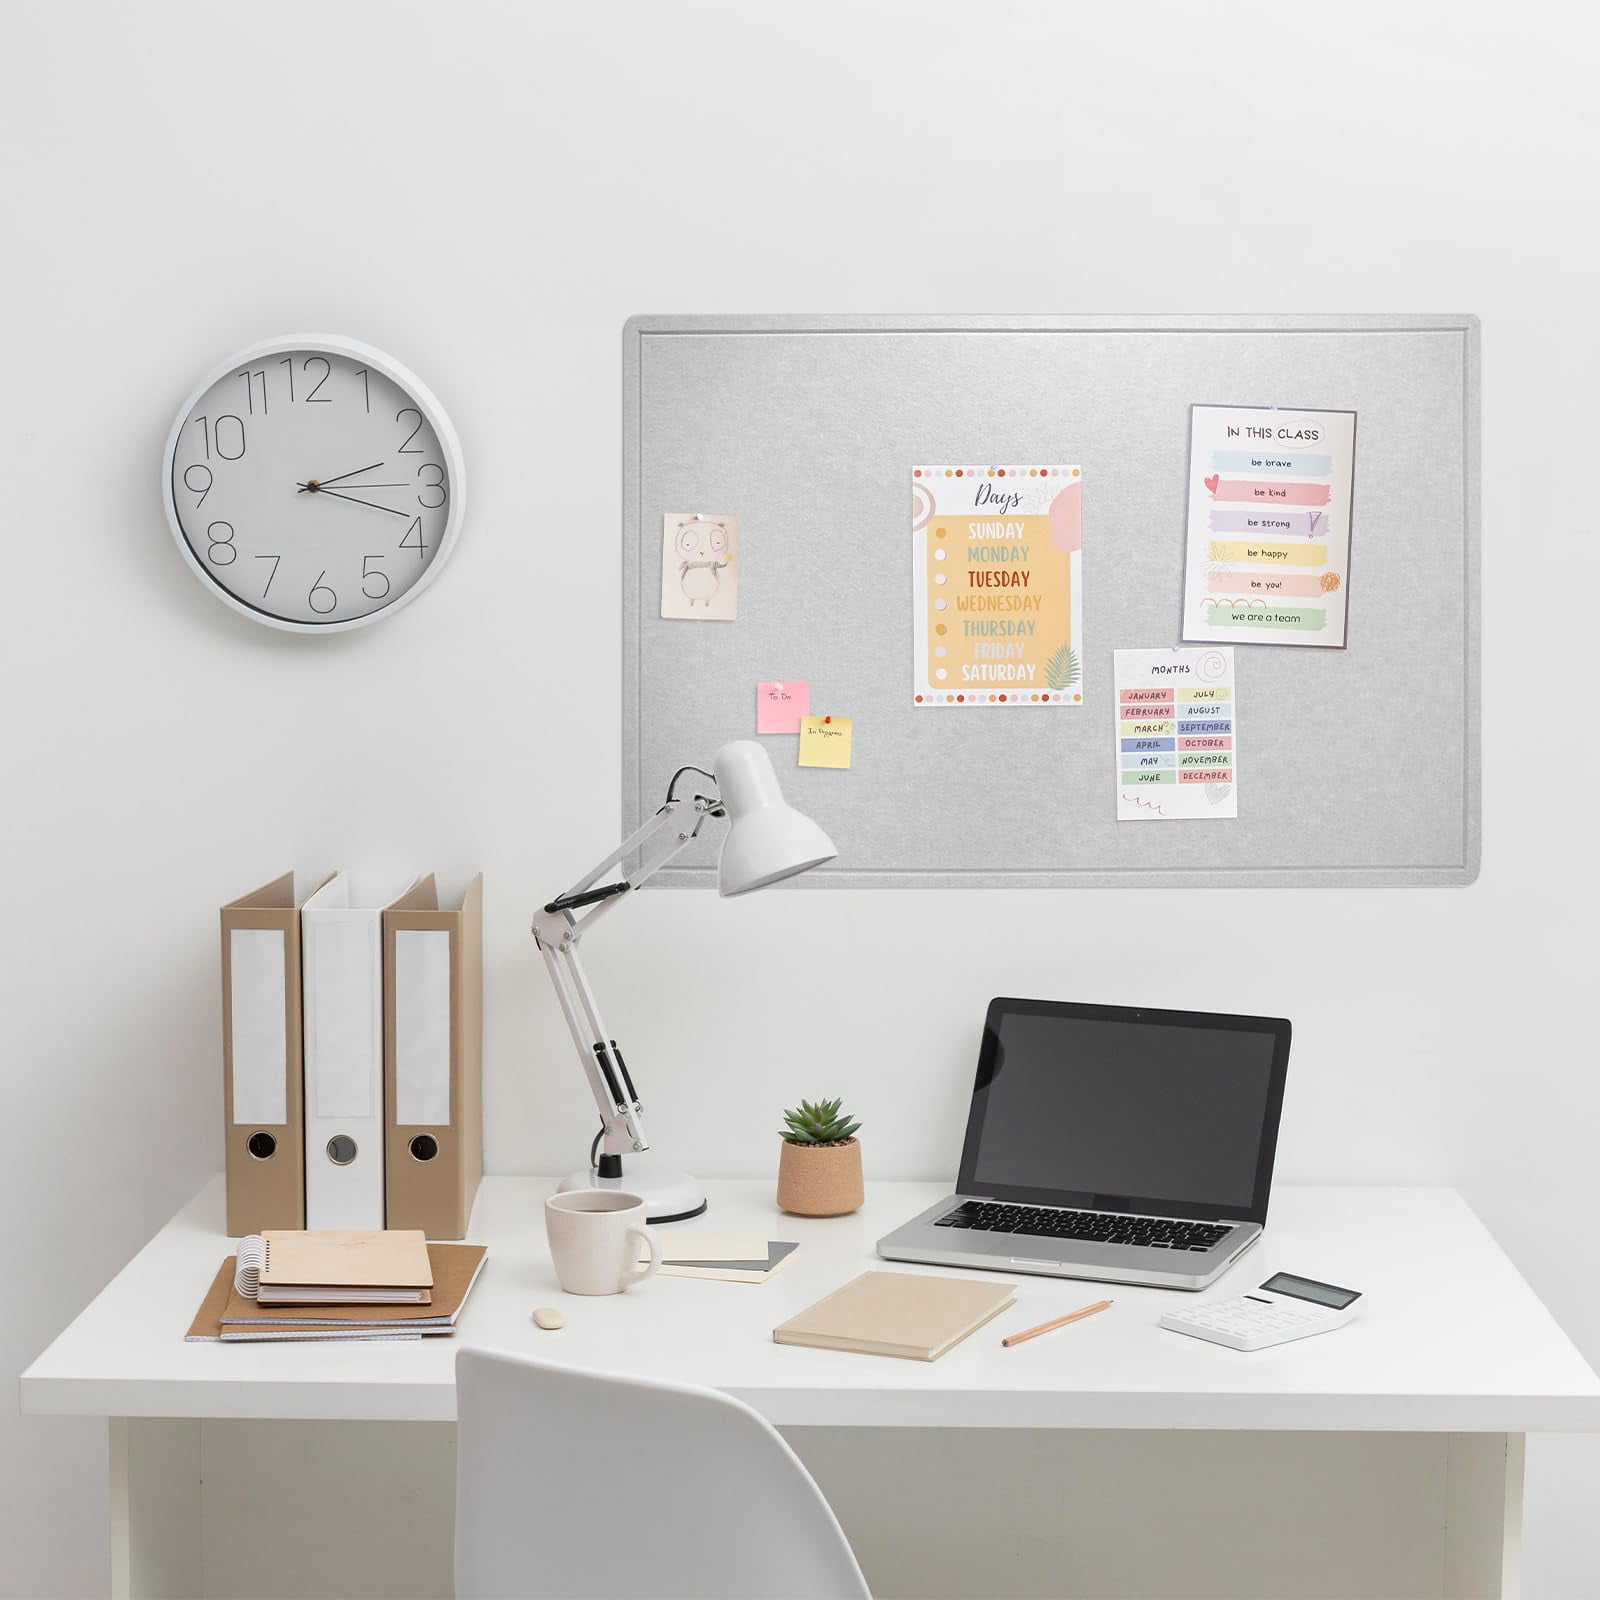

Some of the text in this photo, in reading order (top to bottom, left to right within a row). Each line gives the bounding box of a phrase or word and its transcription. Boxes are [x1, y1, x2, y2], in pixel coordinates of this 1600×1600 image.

[280, 356, 333, 403] 12
[238, 369, 268, 415] 11
[355, 369, 370, 413] 1
[195, 414, 246, 461] 10
[396, 408, 424, 454] 2
[1227, 425, 1320, 441] IN THIS CLASS
[1251, 458, 1292, 468] be brave
[184, 464, 213, 509] 9
[417, 463, 447, 508] 3
[1254, 488, 1287, 498] be kind
[974, 482, 1024, 515] Days
[968, 522, 1025, 540] SUNDAY
[1247, 518, 1291, 529] be strong
[207, 521, 237, 565] 8
[398, 516, 429, 560] 4
[967, 546, 1030, 563] MONDAY
[1247, 549, 1288, 559] be happy
[254, 555, 281, 599] 7
[362, 555, 390, 599] 5
[967, 570, 1030, 588] TUESDAY
[1251, 580, 1283, 590] be you!
[308, 570, 337, 614] 6
[956, 595, 1042, 612] WEDNESDAY
[1231, 612, 1301, 623] we are a team
[963, 620, 1036, 637] THURSDAY
[974, 643, 1025, 660] FRIDAY
[961, 664, 1036, 681] SATURDAY
[1151, 665, 1191, 675] MONTHS
[769, 693, 792, 701] To Do
[1128, 691, 1167, 700] JANUARY
[1193, 690, 1215, 699] JULY
[1125, 707, 1170, 716] FEBRUARY
[1187, 706, 1221, 715] AUGUST
[1134, 724, 1164, 733] MARCH
[1180, 723, 1230, 732] SEPTEMBER
[1135, 740, 1161, 749] APRIL
[1185, 739, 1224, 747] OCTOBER
[1140, 757, 1159, 766] MAY
[1182, 756, 1229, 765] NOVEMBER
[1138, 773, 1161, 782] JUNE
[1183, 771, 1228, 780] DECEMBER
